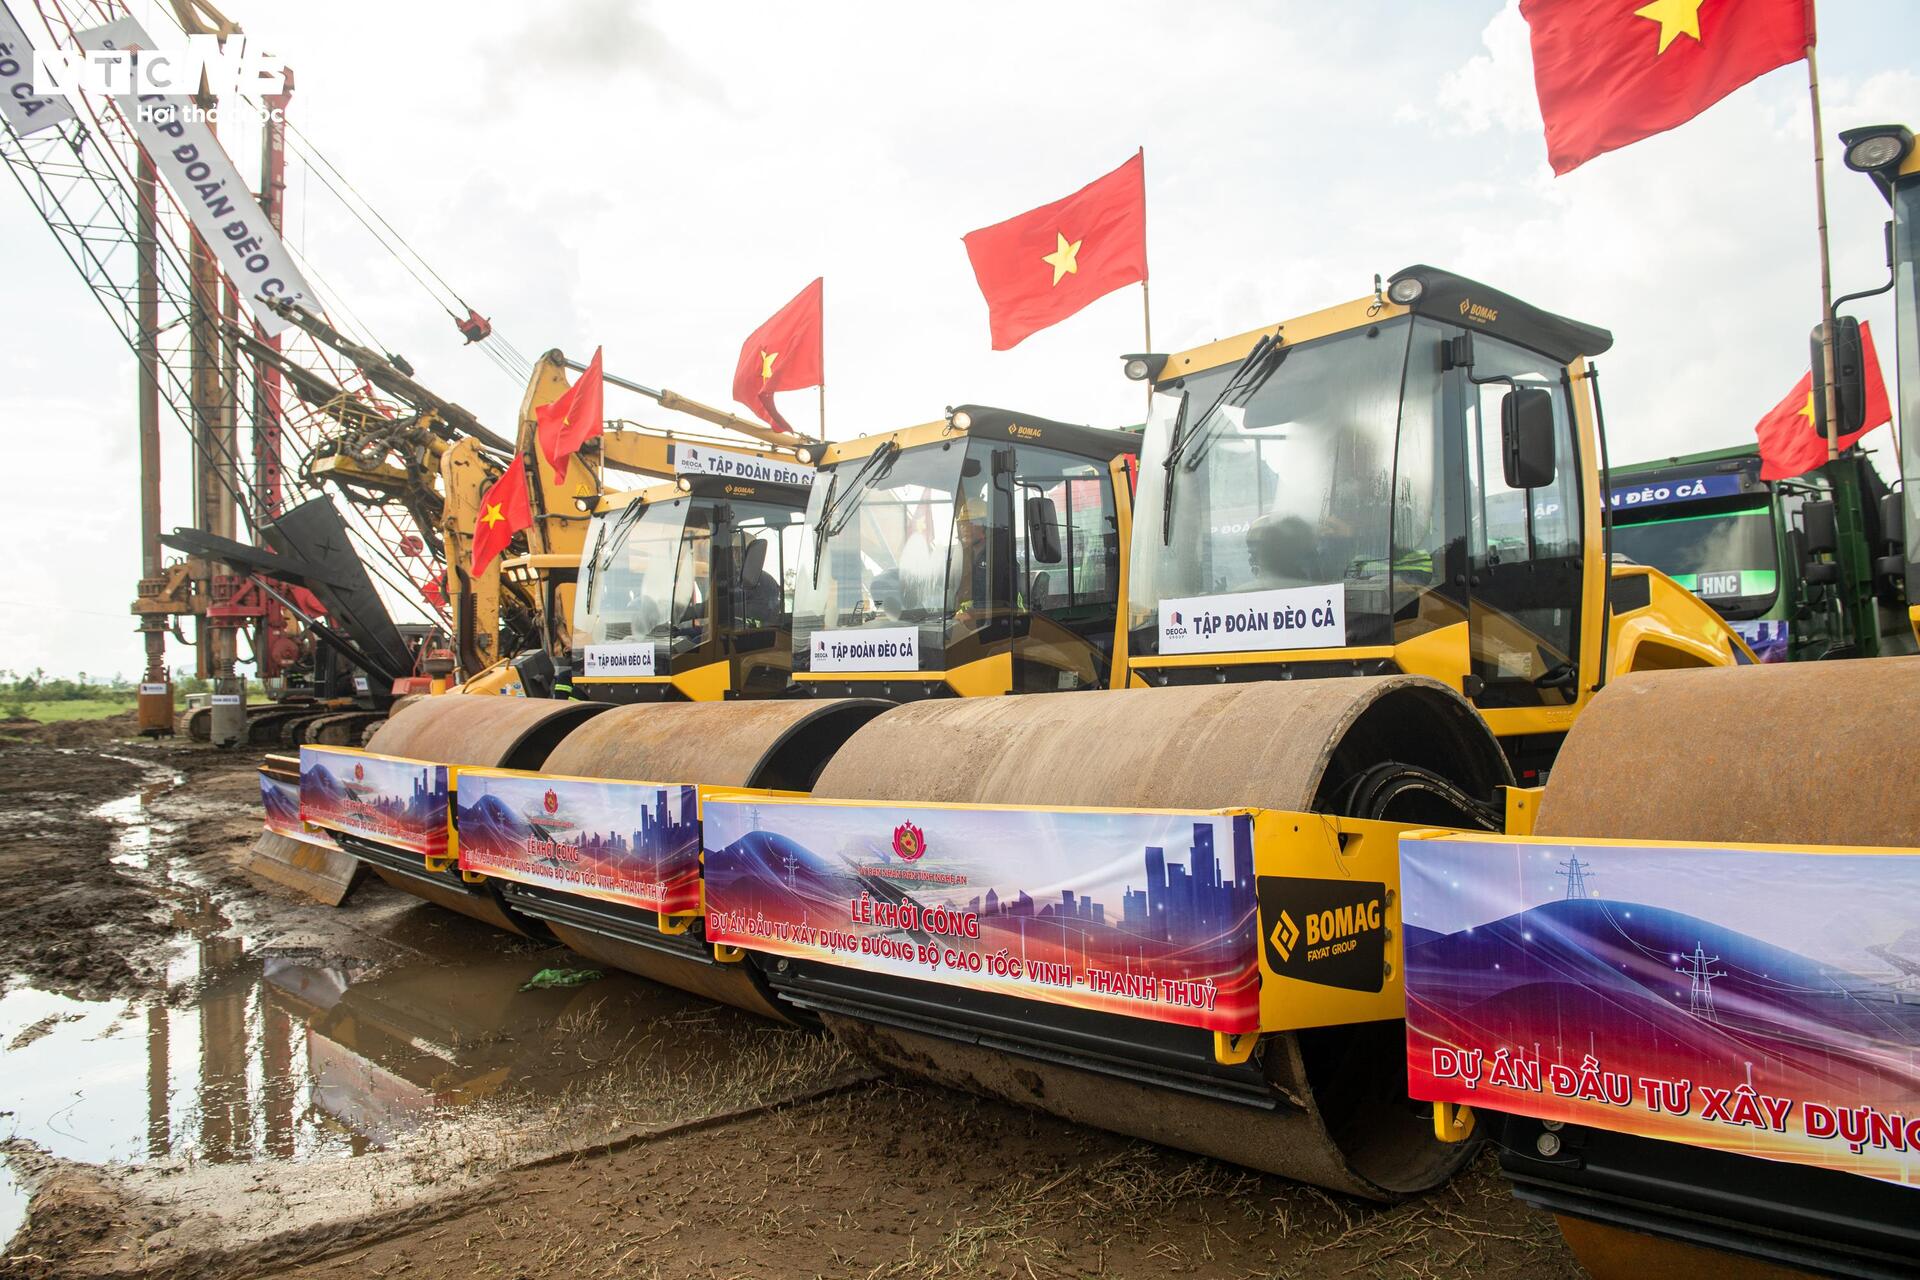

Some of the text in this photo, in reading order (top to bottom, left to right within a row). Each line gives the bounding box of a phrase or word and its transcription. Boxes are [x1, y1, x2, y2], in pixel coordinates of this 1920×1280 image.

[172, 143, 235, 218] ĐOÀN
[222, 220, 270, 274] ĐÈO
[1470, 303, 1498, 321] BOMAG
[1018, 426, 1041, 437] BOMAG
[736, 463, 770, 481] ĐOÀN
[774, 467, 798, 484] ĐÈO
[1626, 488, 1670, 504] ĐÈO
[1676, 479, 1707, 497] CẢ
[1702, 575, 1737, 595] HNC
[1193, 599, 1336, 639] TẬP ĐOÀN ĐÈO CẢ
[1165, 628, 1188, 636] DEOCA
[598, 653, 609, 669] TẬP
[610, 652, 627, 666] ĐOÀN
[628, 652, 641, 666] ĐÈO
[642, 650, 651, 666] CẢ
[831, 636, 913, 662] TẬP ĐOÀN ĐÈO CẢ
[850, 890, 980, 939] LỄ KHỞI CÔNG
[1306, 899, 1380, 946] BOMAG
[710, 912, 728, 934] DỰ
[729, 908, 746, 933] ÁN
[747, 912, 771, 938] ĐẦU
[774, 921, 790, 941] TƯ
[791, 922, 818, 944] XÂY
[819, 930, 858, 955] DỰNG
[861, 933, 914, 962] ĐƯỜNG
[917, 941, 942, 971] BỘ
[943, 949, 981, 973] CAO
[984, 948, 1023, 979] TỐC
[1026, 960, 1073, 988] VINH
[1087, 968, 1157, 1001] THANH
[1162, 977, 1218, 1011] THUỶ
[1307, 939, 1357, 962] FAYAT GROUP
[1432, 1047, 1482, 1089] DỰ
[1489, 1048, 1542, 1092] ÁN
[1549, 1054, 1632, 1107] ĐẦU
[1638, 1077, 1691, 1116] TƯ
[1699, 1083, 1793, 1133] XÂY
